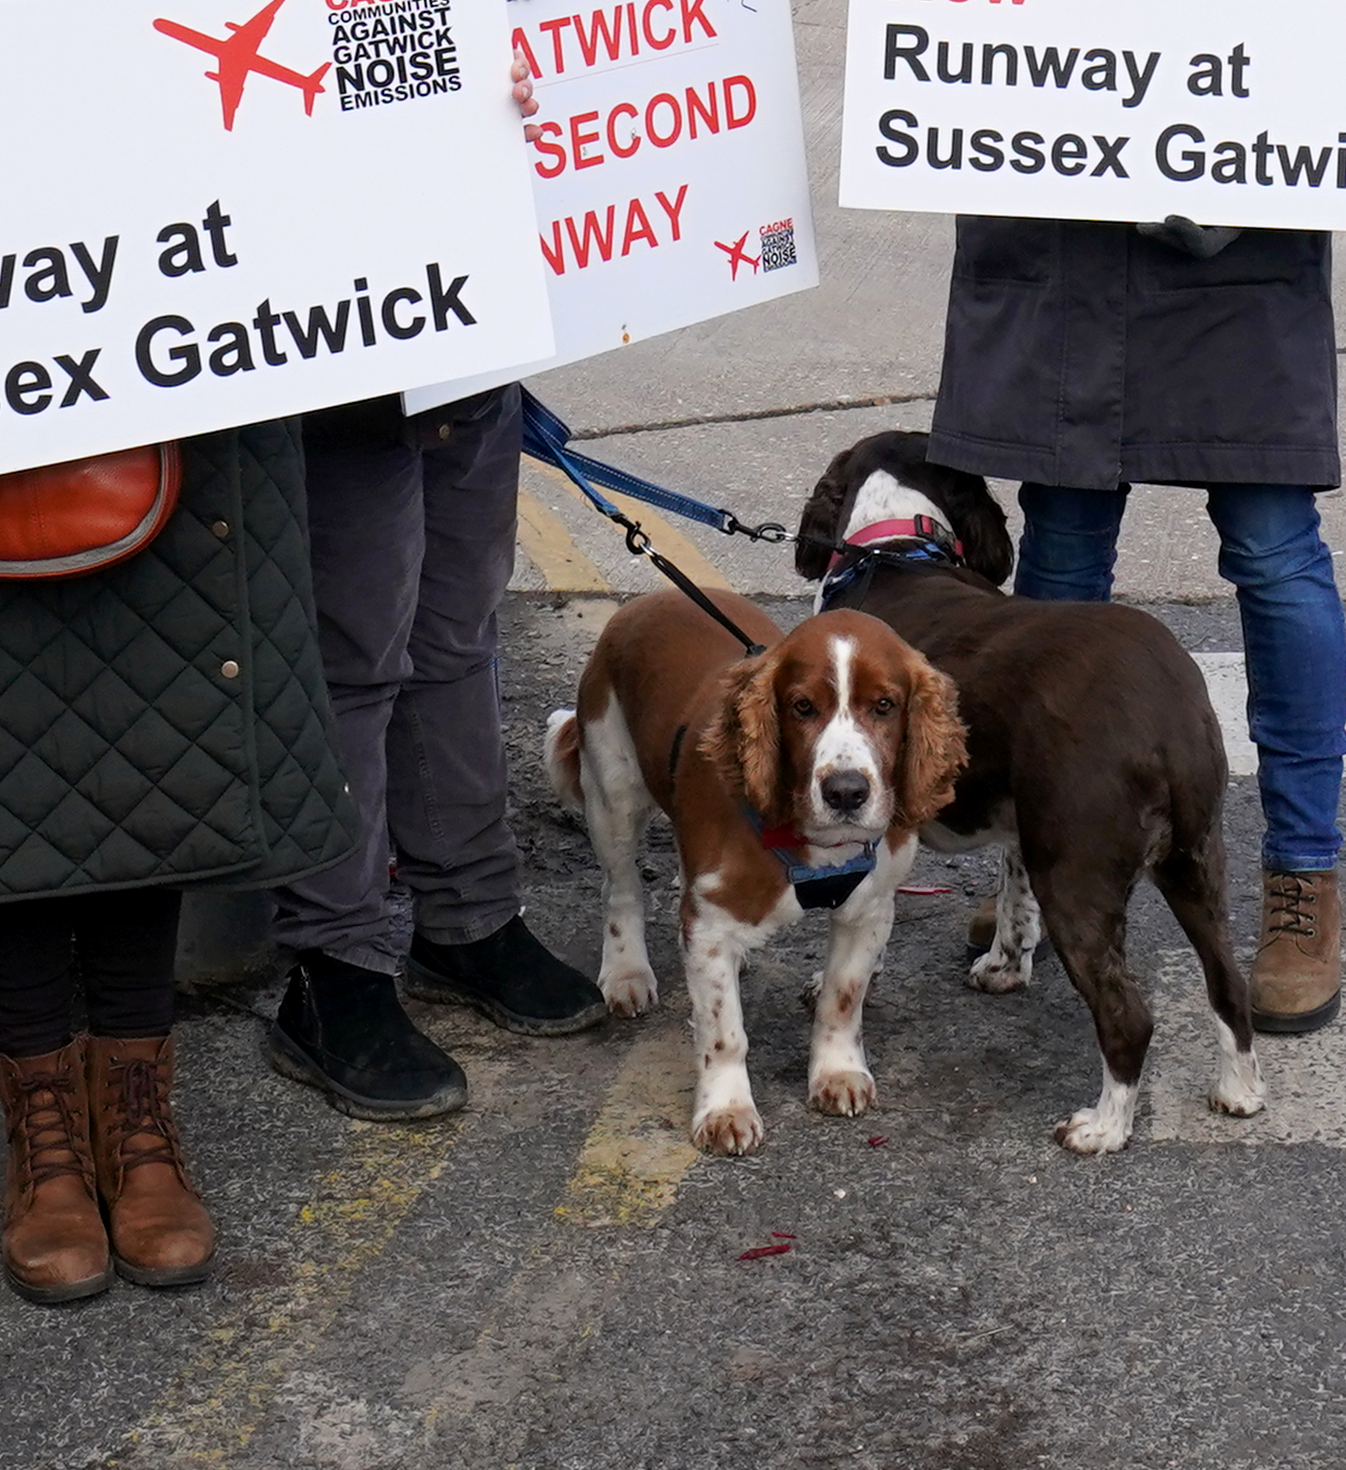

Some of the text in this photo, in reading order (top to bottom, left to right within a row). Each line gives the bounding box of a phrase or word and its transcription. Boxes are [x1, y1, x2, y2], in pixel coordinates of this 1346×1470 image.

[332, 6, 451, 46] AGAINST
[333, 27, 454, 65] GATWICK
[335, 46, 460, 96] NOISE
[340, 75, 462, 112] EMISSIONS
[883, 24, 1251, 108] Runway at
[533, 75, 757, 179] SECOND
[875, 109, 1130, 178] Sussex
[156, 199, 238, 278] at
[539, 184, 689, 276] NWAY
[759, 217, 793, 236] CAGNE
[763, 246, 796, 266] NOISE
[135, 262, 477, 388] Gatwick
